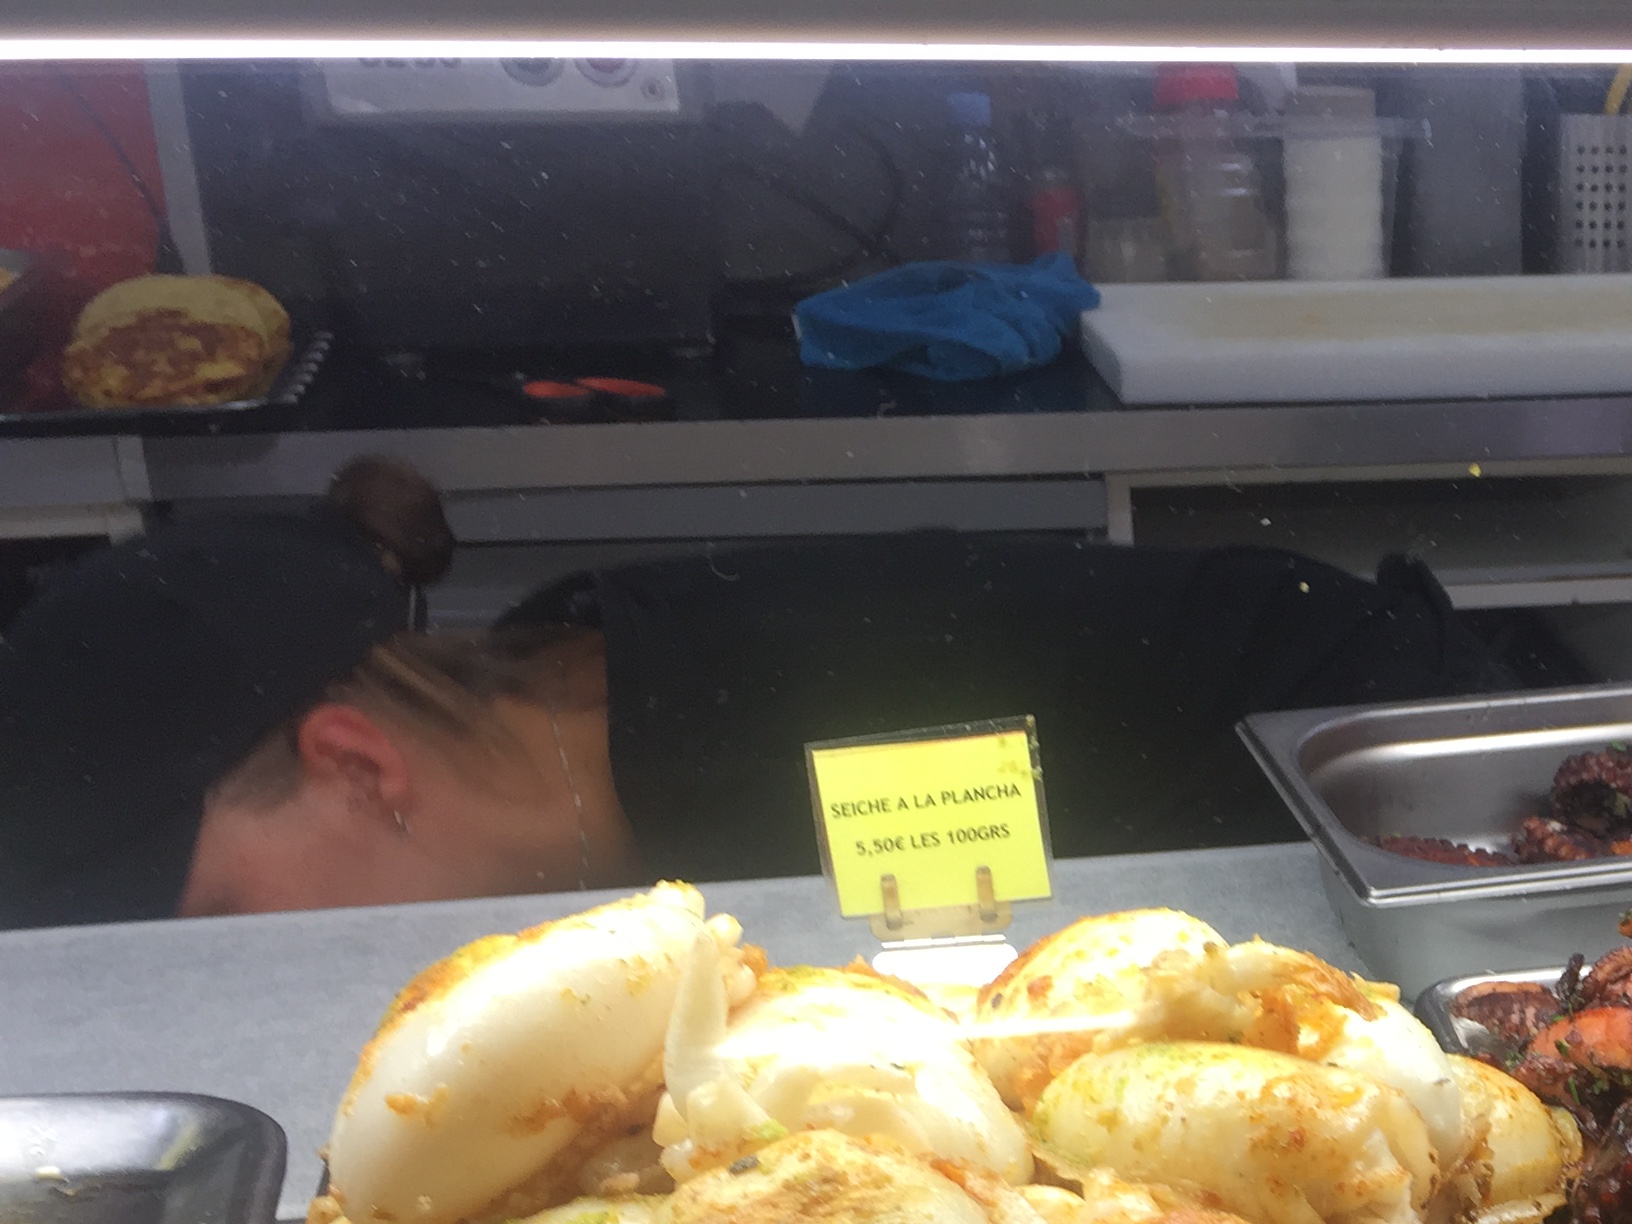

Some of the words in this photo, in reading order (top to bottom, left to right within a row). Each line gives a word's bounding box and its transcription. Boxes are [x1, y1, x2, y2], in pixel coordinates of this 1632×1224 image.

[831, 797, 890, 818] SEICHE
[897, 797, 909, 811] A
[913, 794, 936, 808] LA
[941, 783, 1022, 805] PLANCHA
[856, 836, 905, 857] 5,50€
[911, 832, 941, 849] LES
[948, 823, 1011, 845] 100GRS
